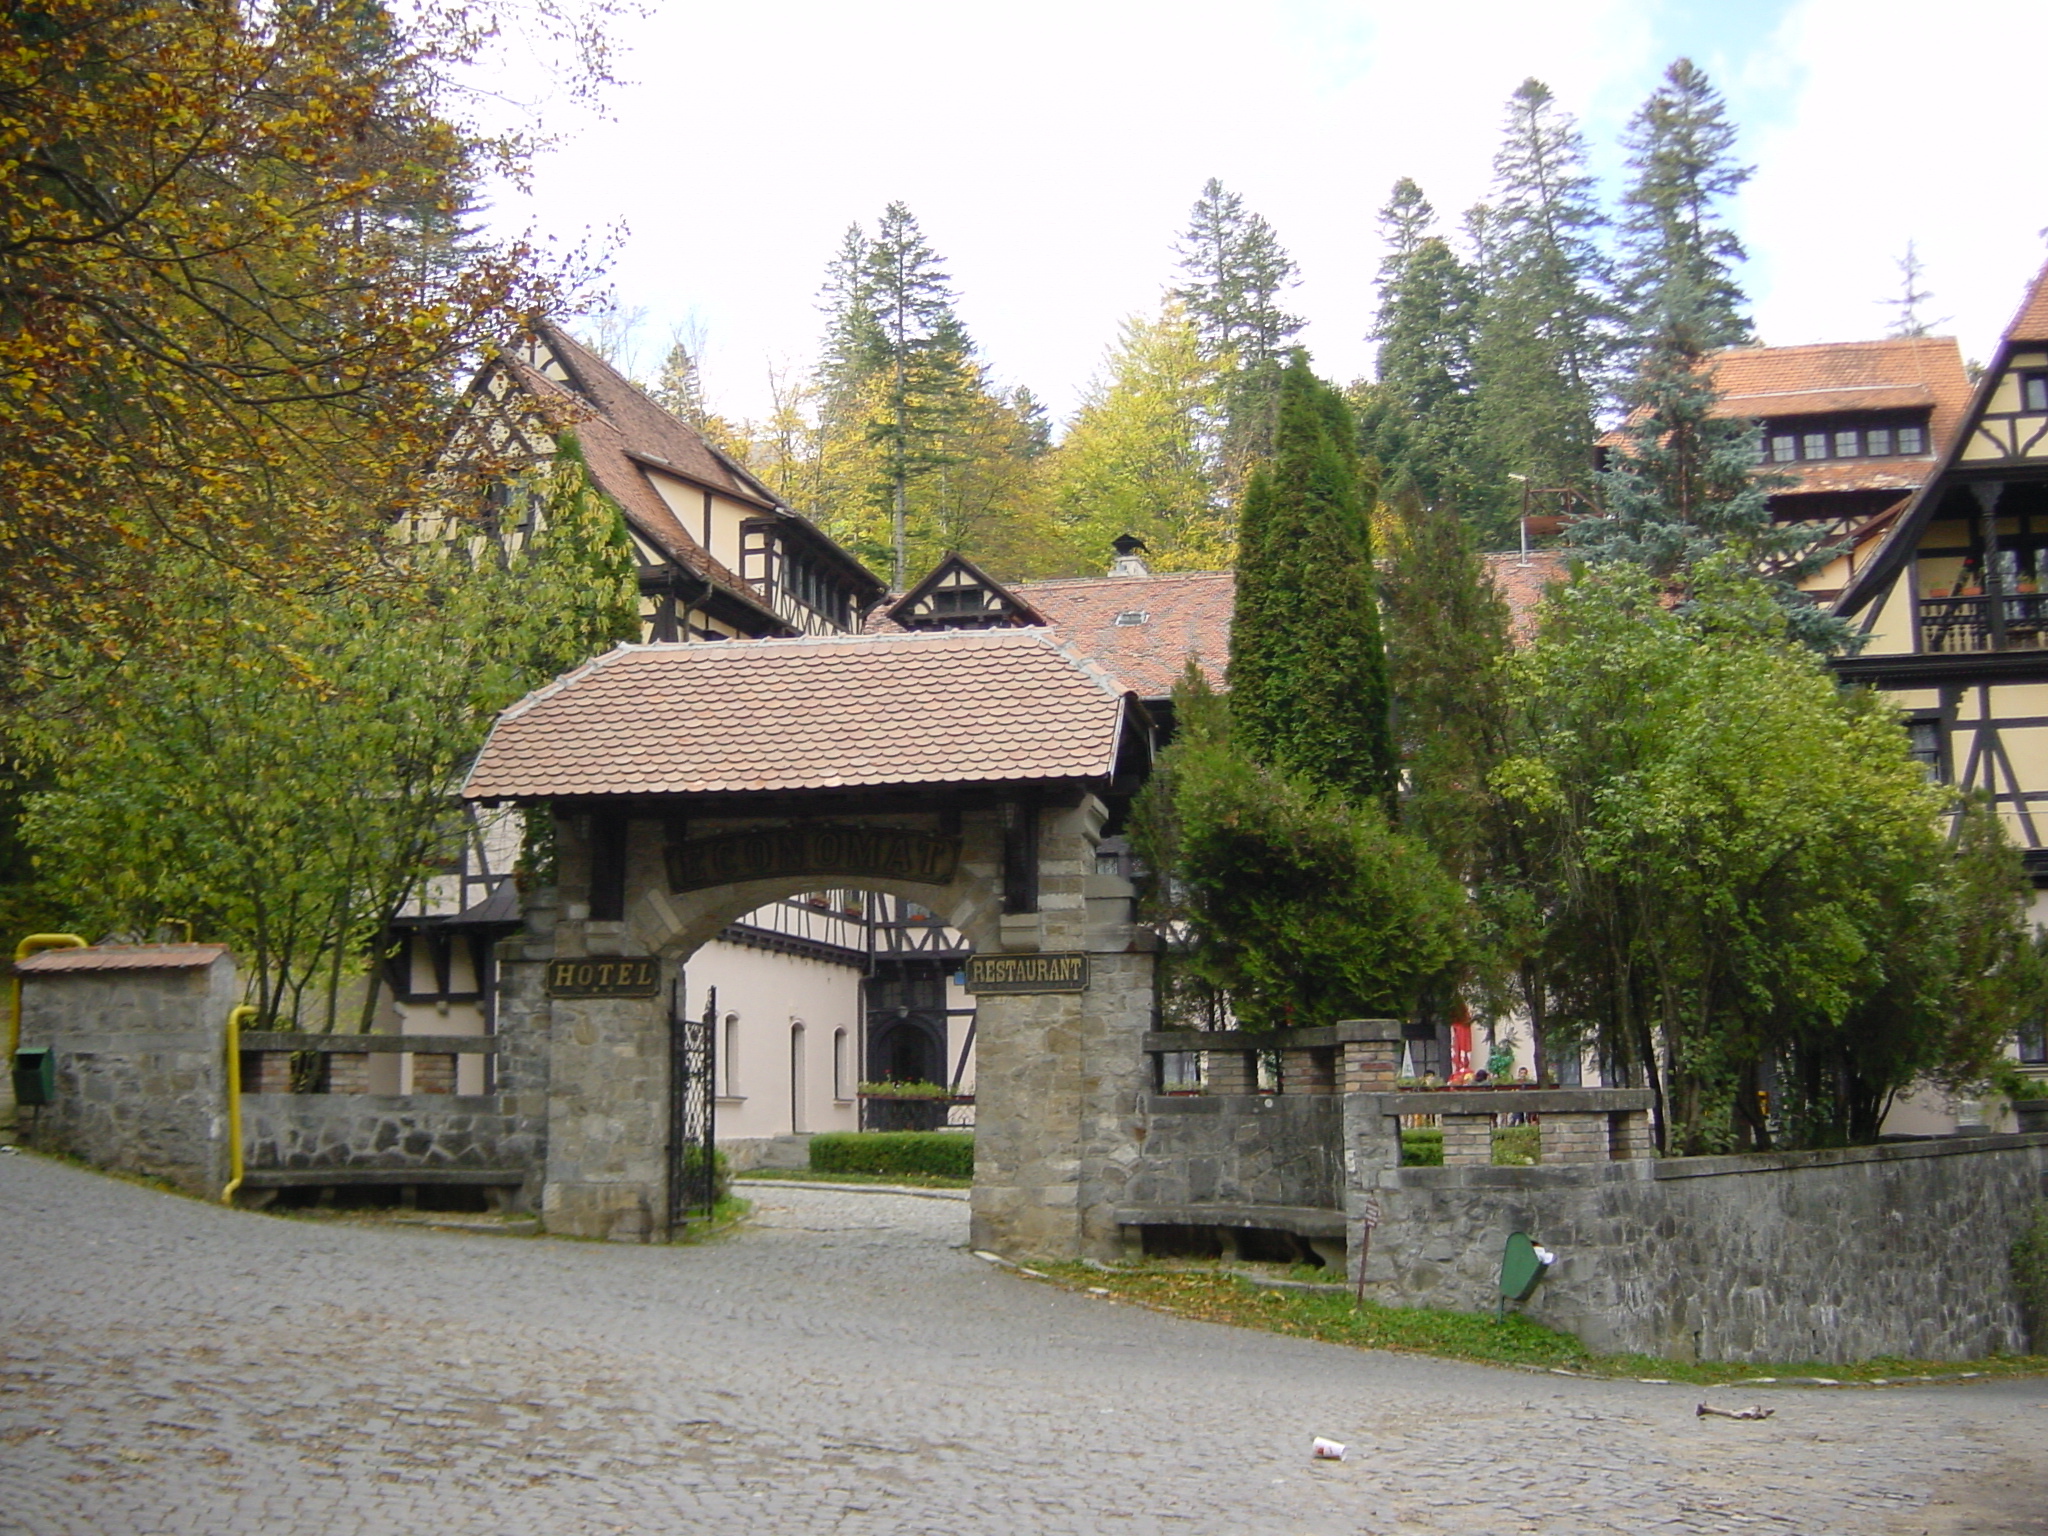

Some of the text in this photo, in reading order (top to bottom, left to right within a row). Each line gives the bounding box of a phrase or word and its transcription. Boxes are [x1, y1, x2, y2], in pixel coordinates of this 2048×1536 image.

[680, 834, 945, 885] ECONOMAT
[554, 963, 652, 986] HOTEL
[973, 958, 1082, 982] RESTAURANT
